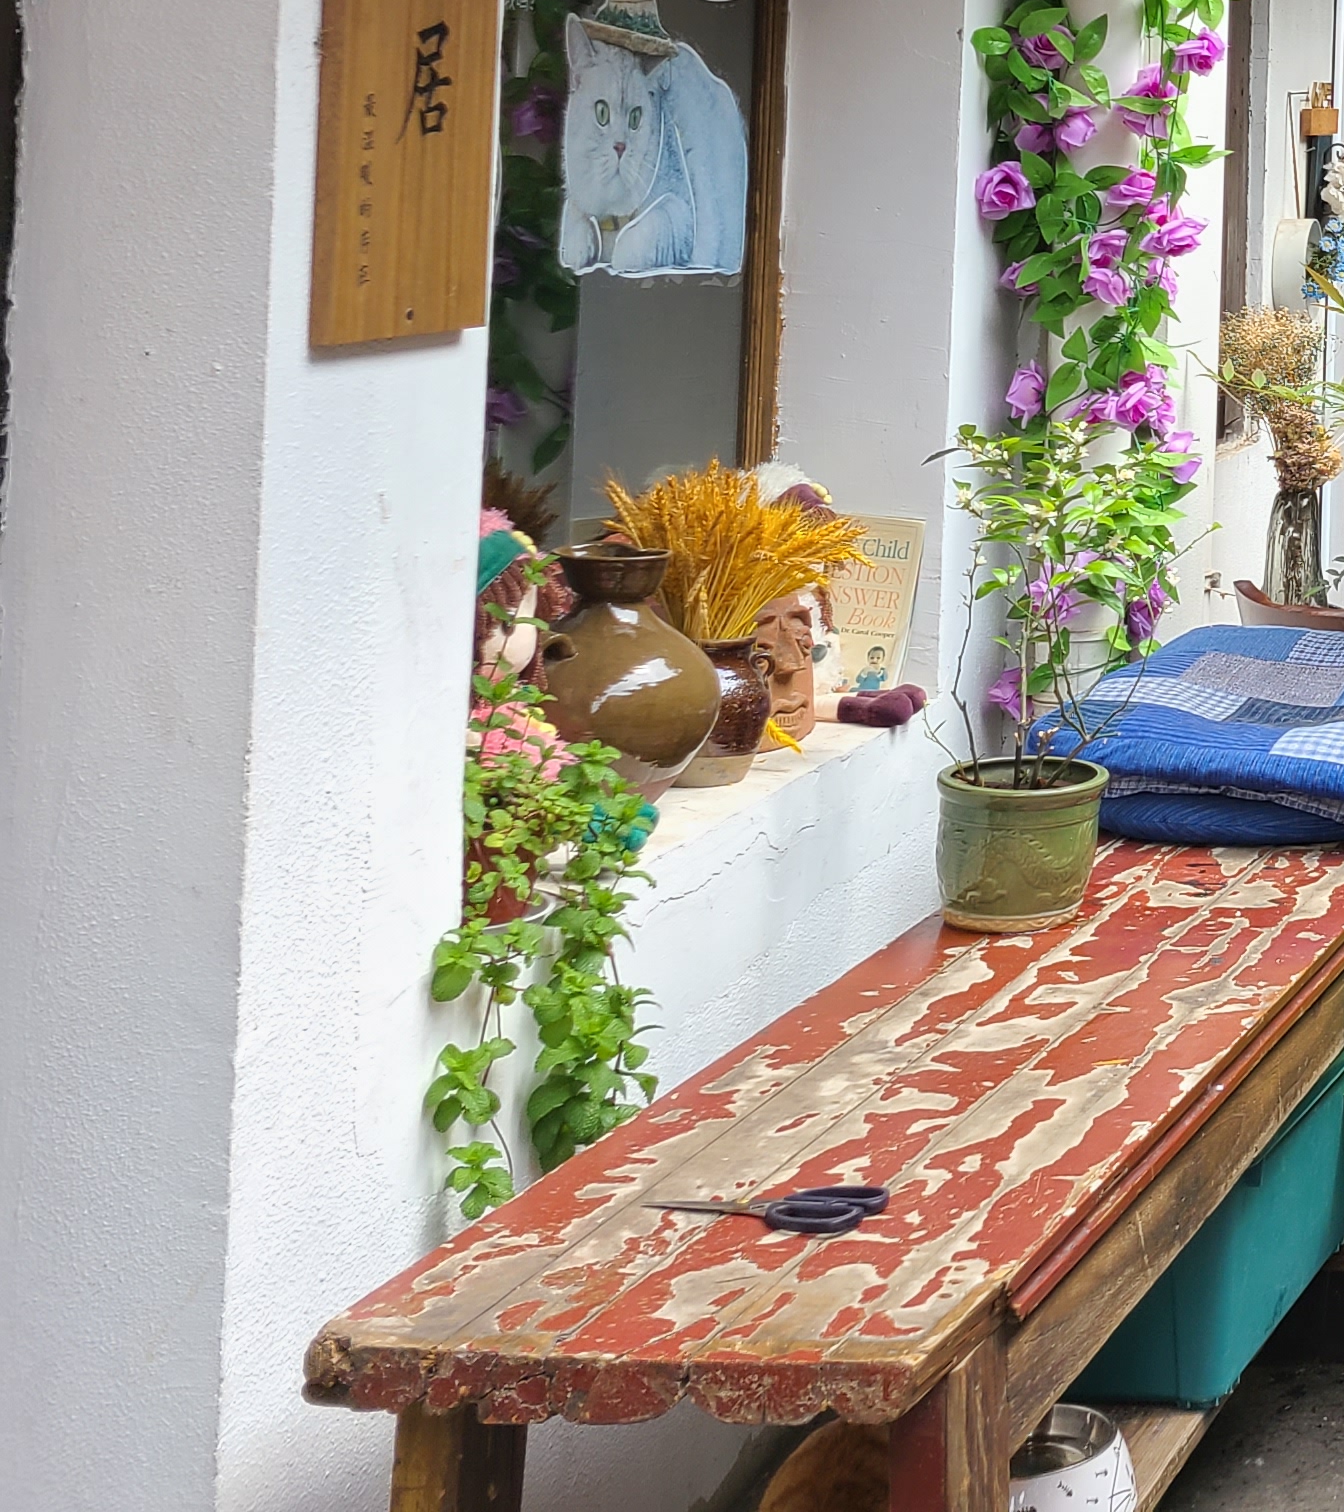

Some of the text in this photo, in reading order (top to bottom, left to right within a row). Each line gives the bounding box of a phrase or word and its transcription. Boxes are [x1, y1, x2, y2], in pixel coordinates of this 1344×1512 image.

[862, 538, 911, 560] Child
[829, 562, 907, 585] ESTION
[827, 585, 900, 610] NSWER
[847, 608, 896, 630] Book
